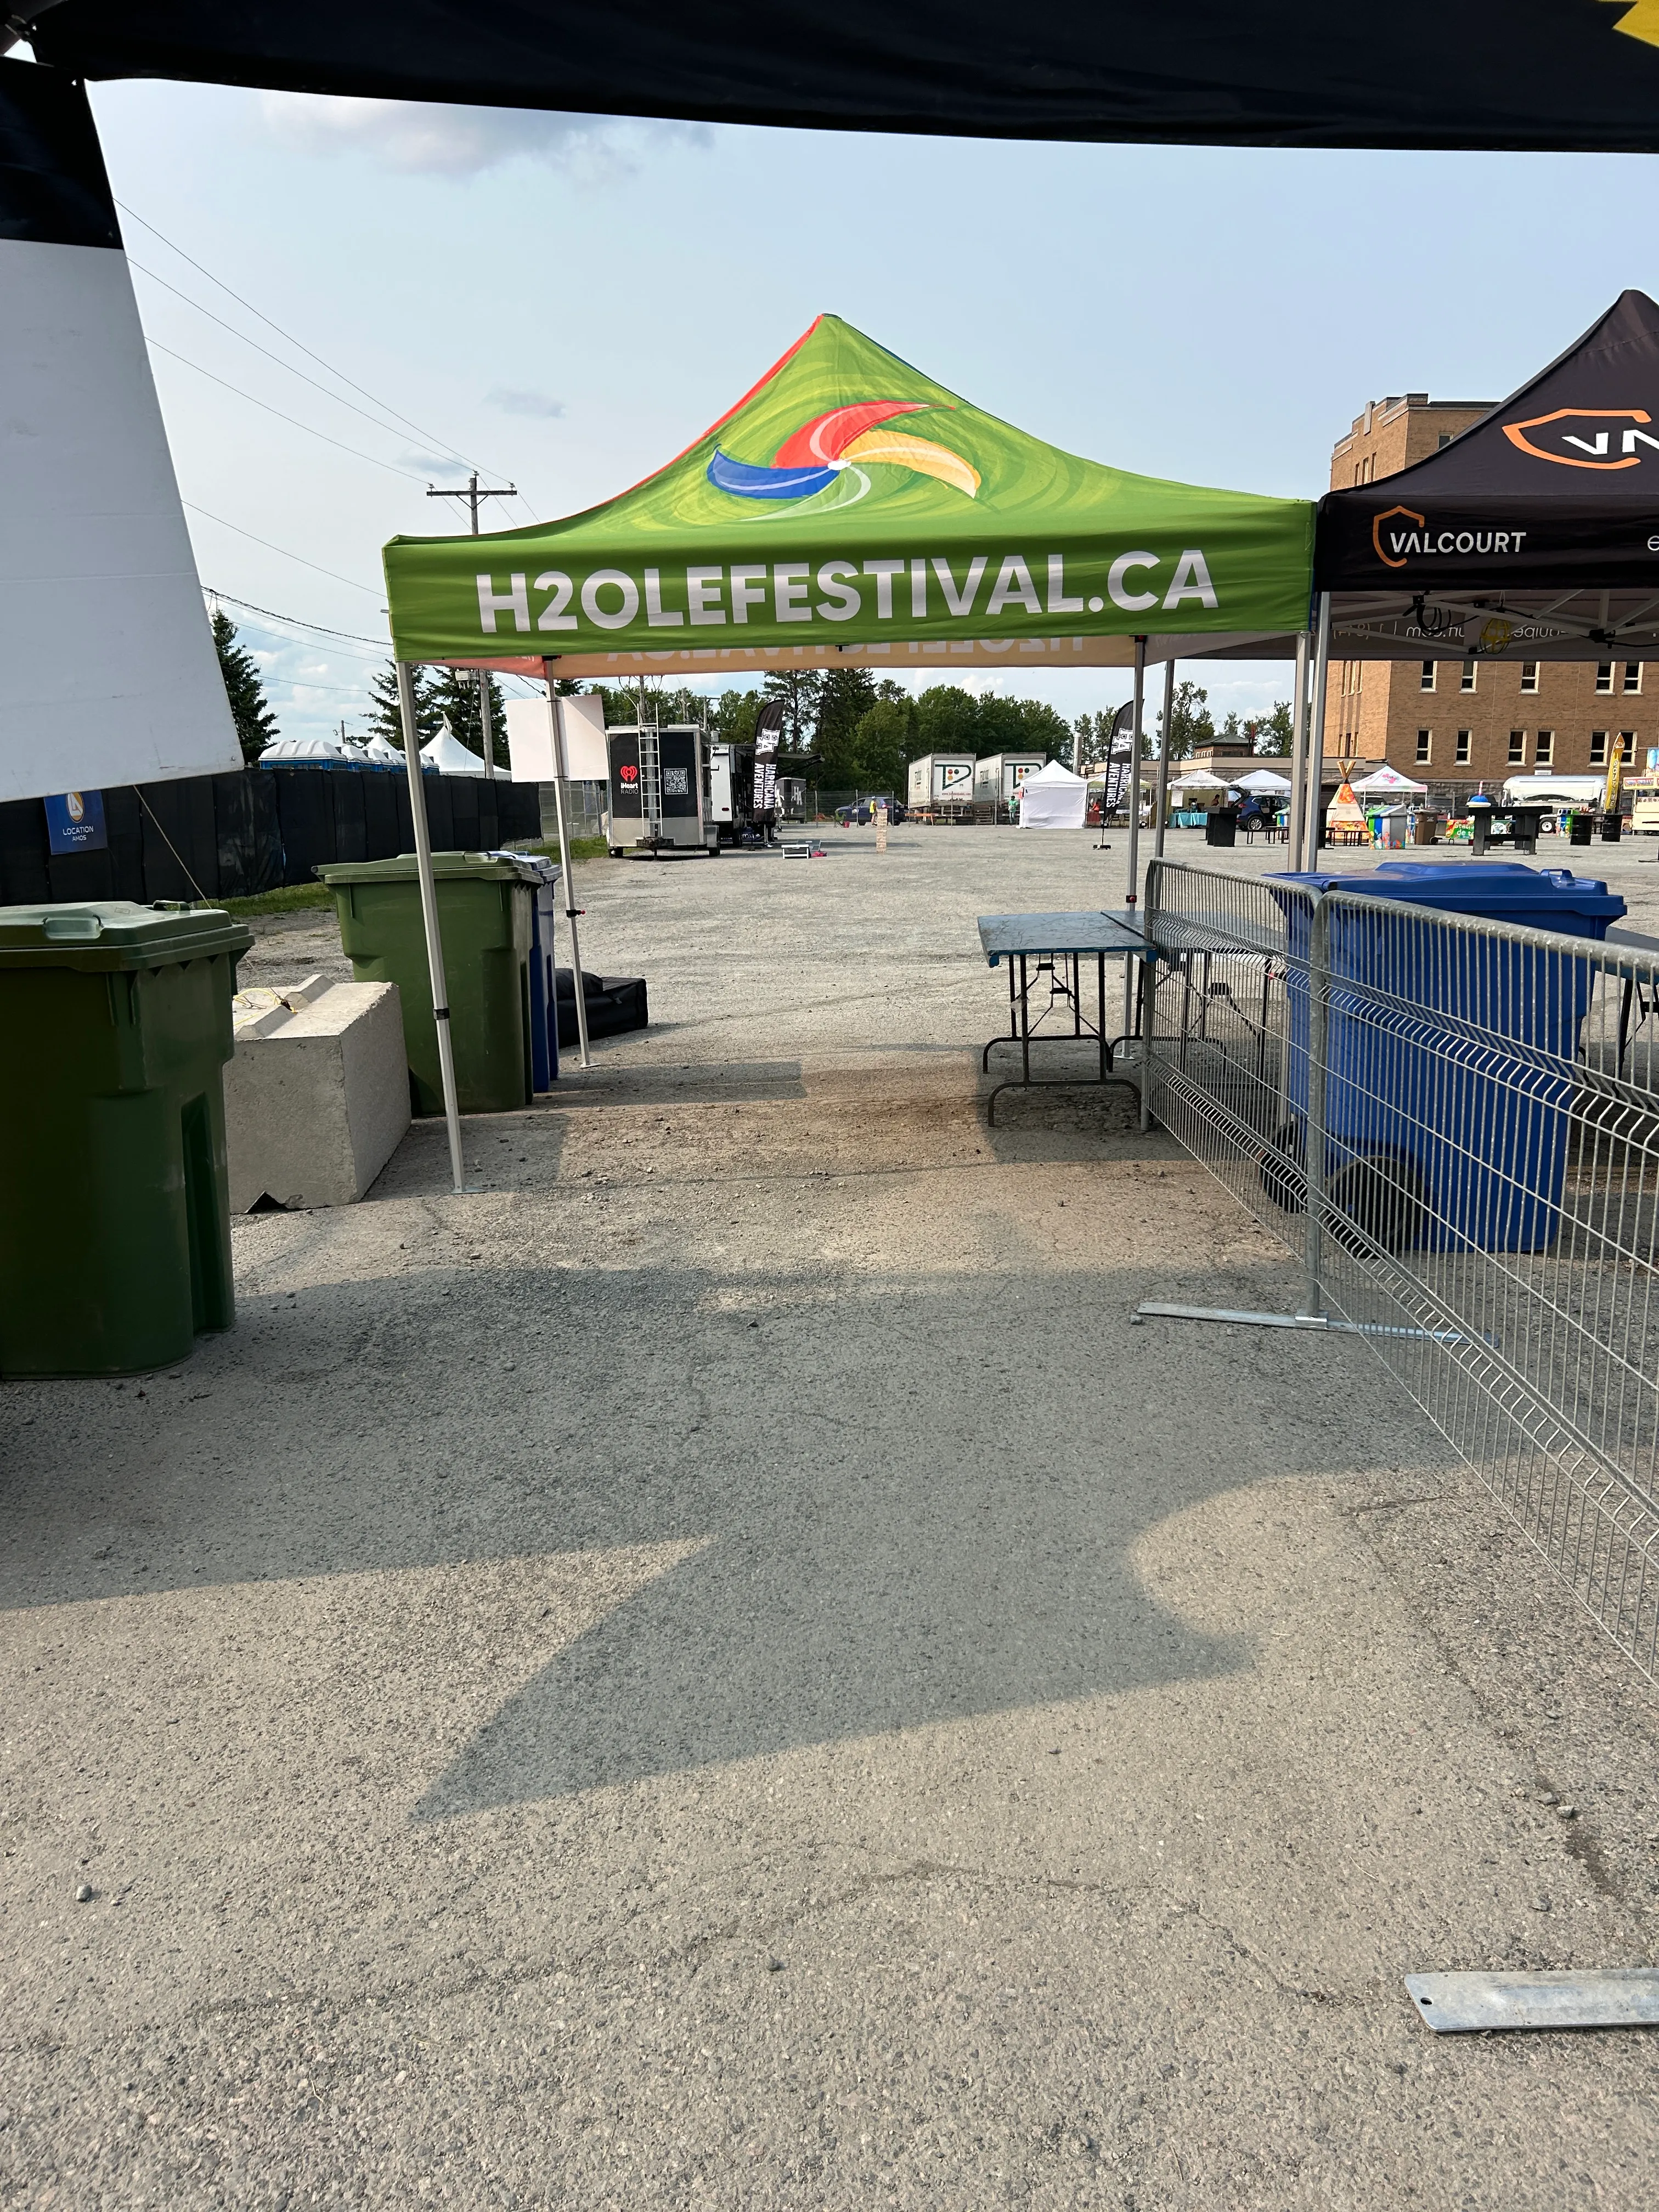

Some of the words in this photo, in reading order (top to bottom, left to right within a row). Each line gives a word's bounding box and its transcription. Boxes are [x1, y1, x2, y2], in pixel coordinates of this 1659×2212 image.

[1390, 532, 1526, 553] VALCOURT
[476, 549, 1219, 634] H2OLEFESTIVAL.CA
[753, 763, 765, 809] AVENTURES
[763, 763, 777, 810] HARRICANA
[1106, 762, 1121, 808] AVENTURES
[63, 825, 94, 836] LOCATION
